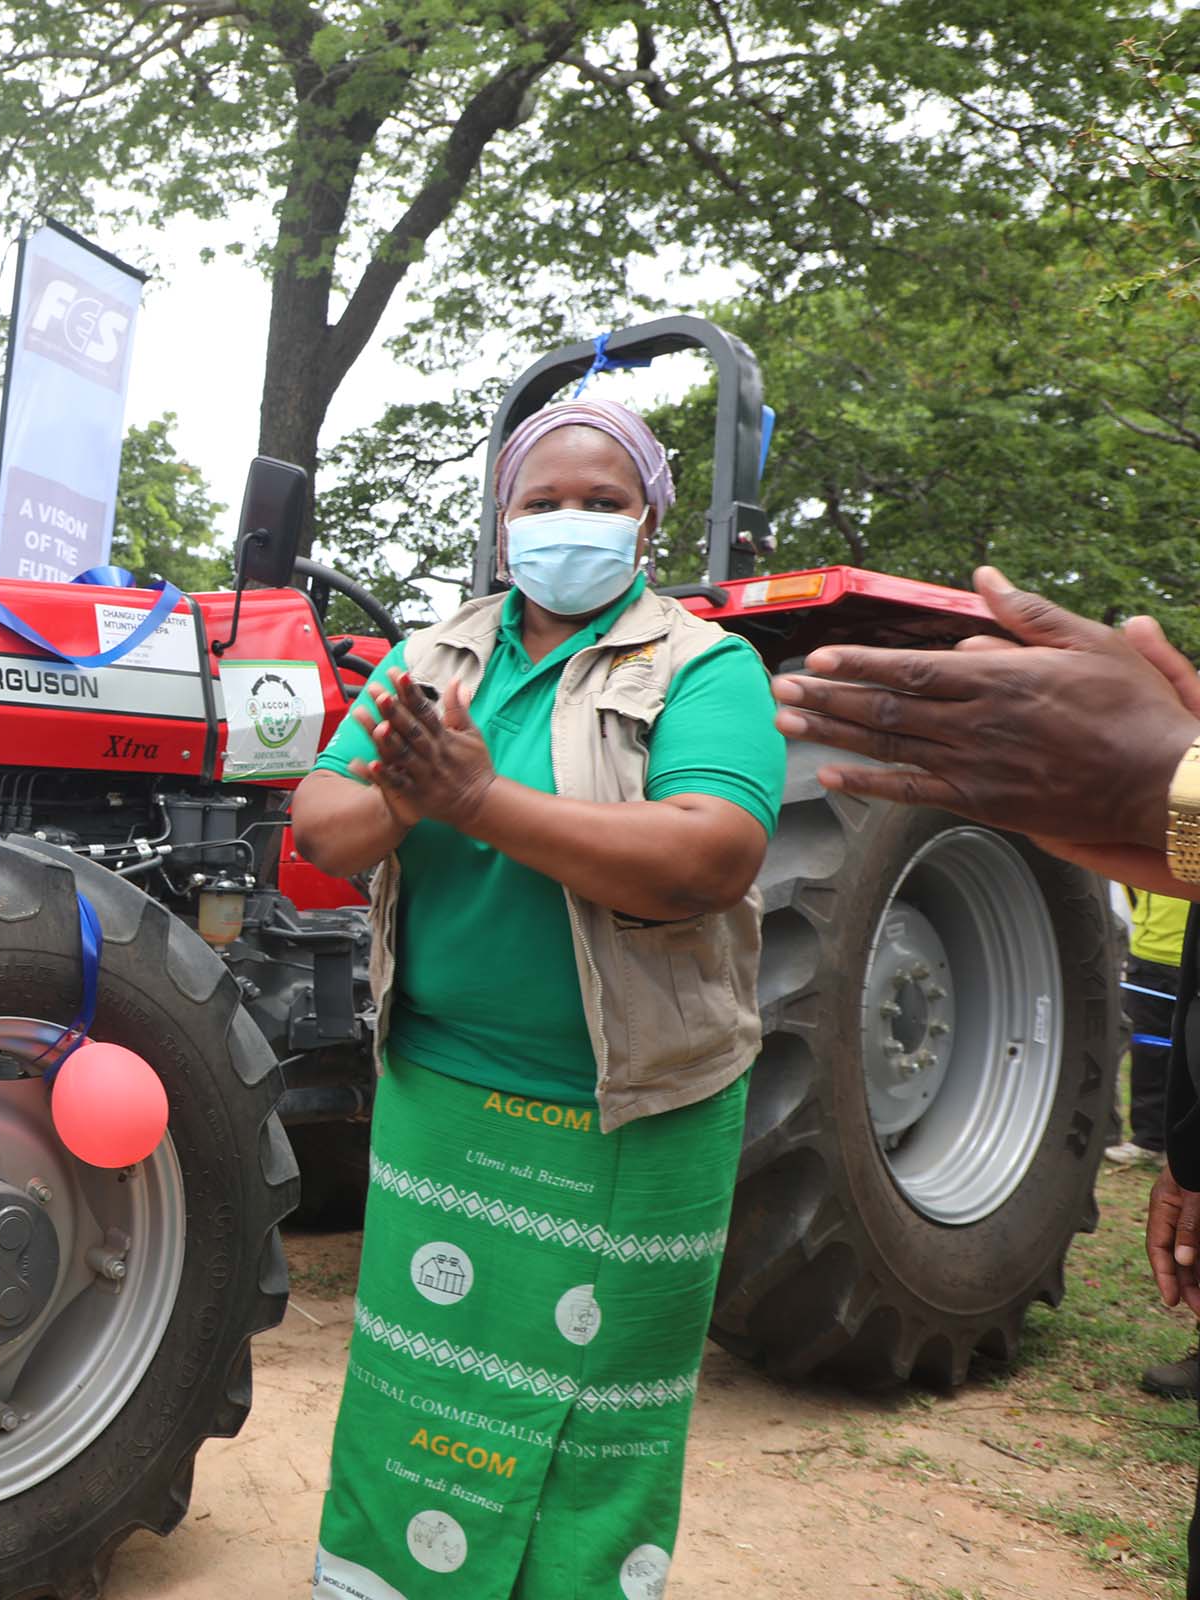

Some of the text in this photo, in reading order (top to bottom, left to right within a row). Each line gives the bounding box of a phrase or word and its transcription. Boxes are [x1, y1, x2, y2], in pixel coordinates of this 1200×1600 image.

[19, 498, 33, 519] A
[25, 530, 52, 552] OF
[102, 609, 135, 621] CHANGU
[102, 735, 159, 760] Xtra
[483, 1090, 593, 1133] AGCOM
[465, 1149, 596, 1194] Ulimi ndi Bizinesi
[409, 1427, 517, 1480] AGCOM
[385, 1458, 504, 1514] Ulimi ndi Bizinesi
[322, 1575, 346, 1591] WORLD
